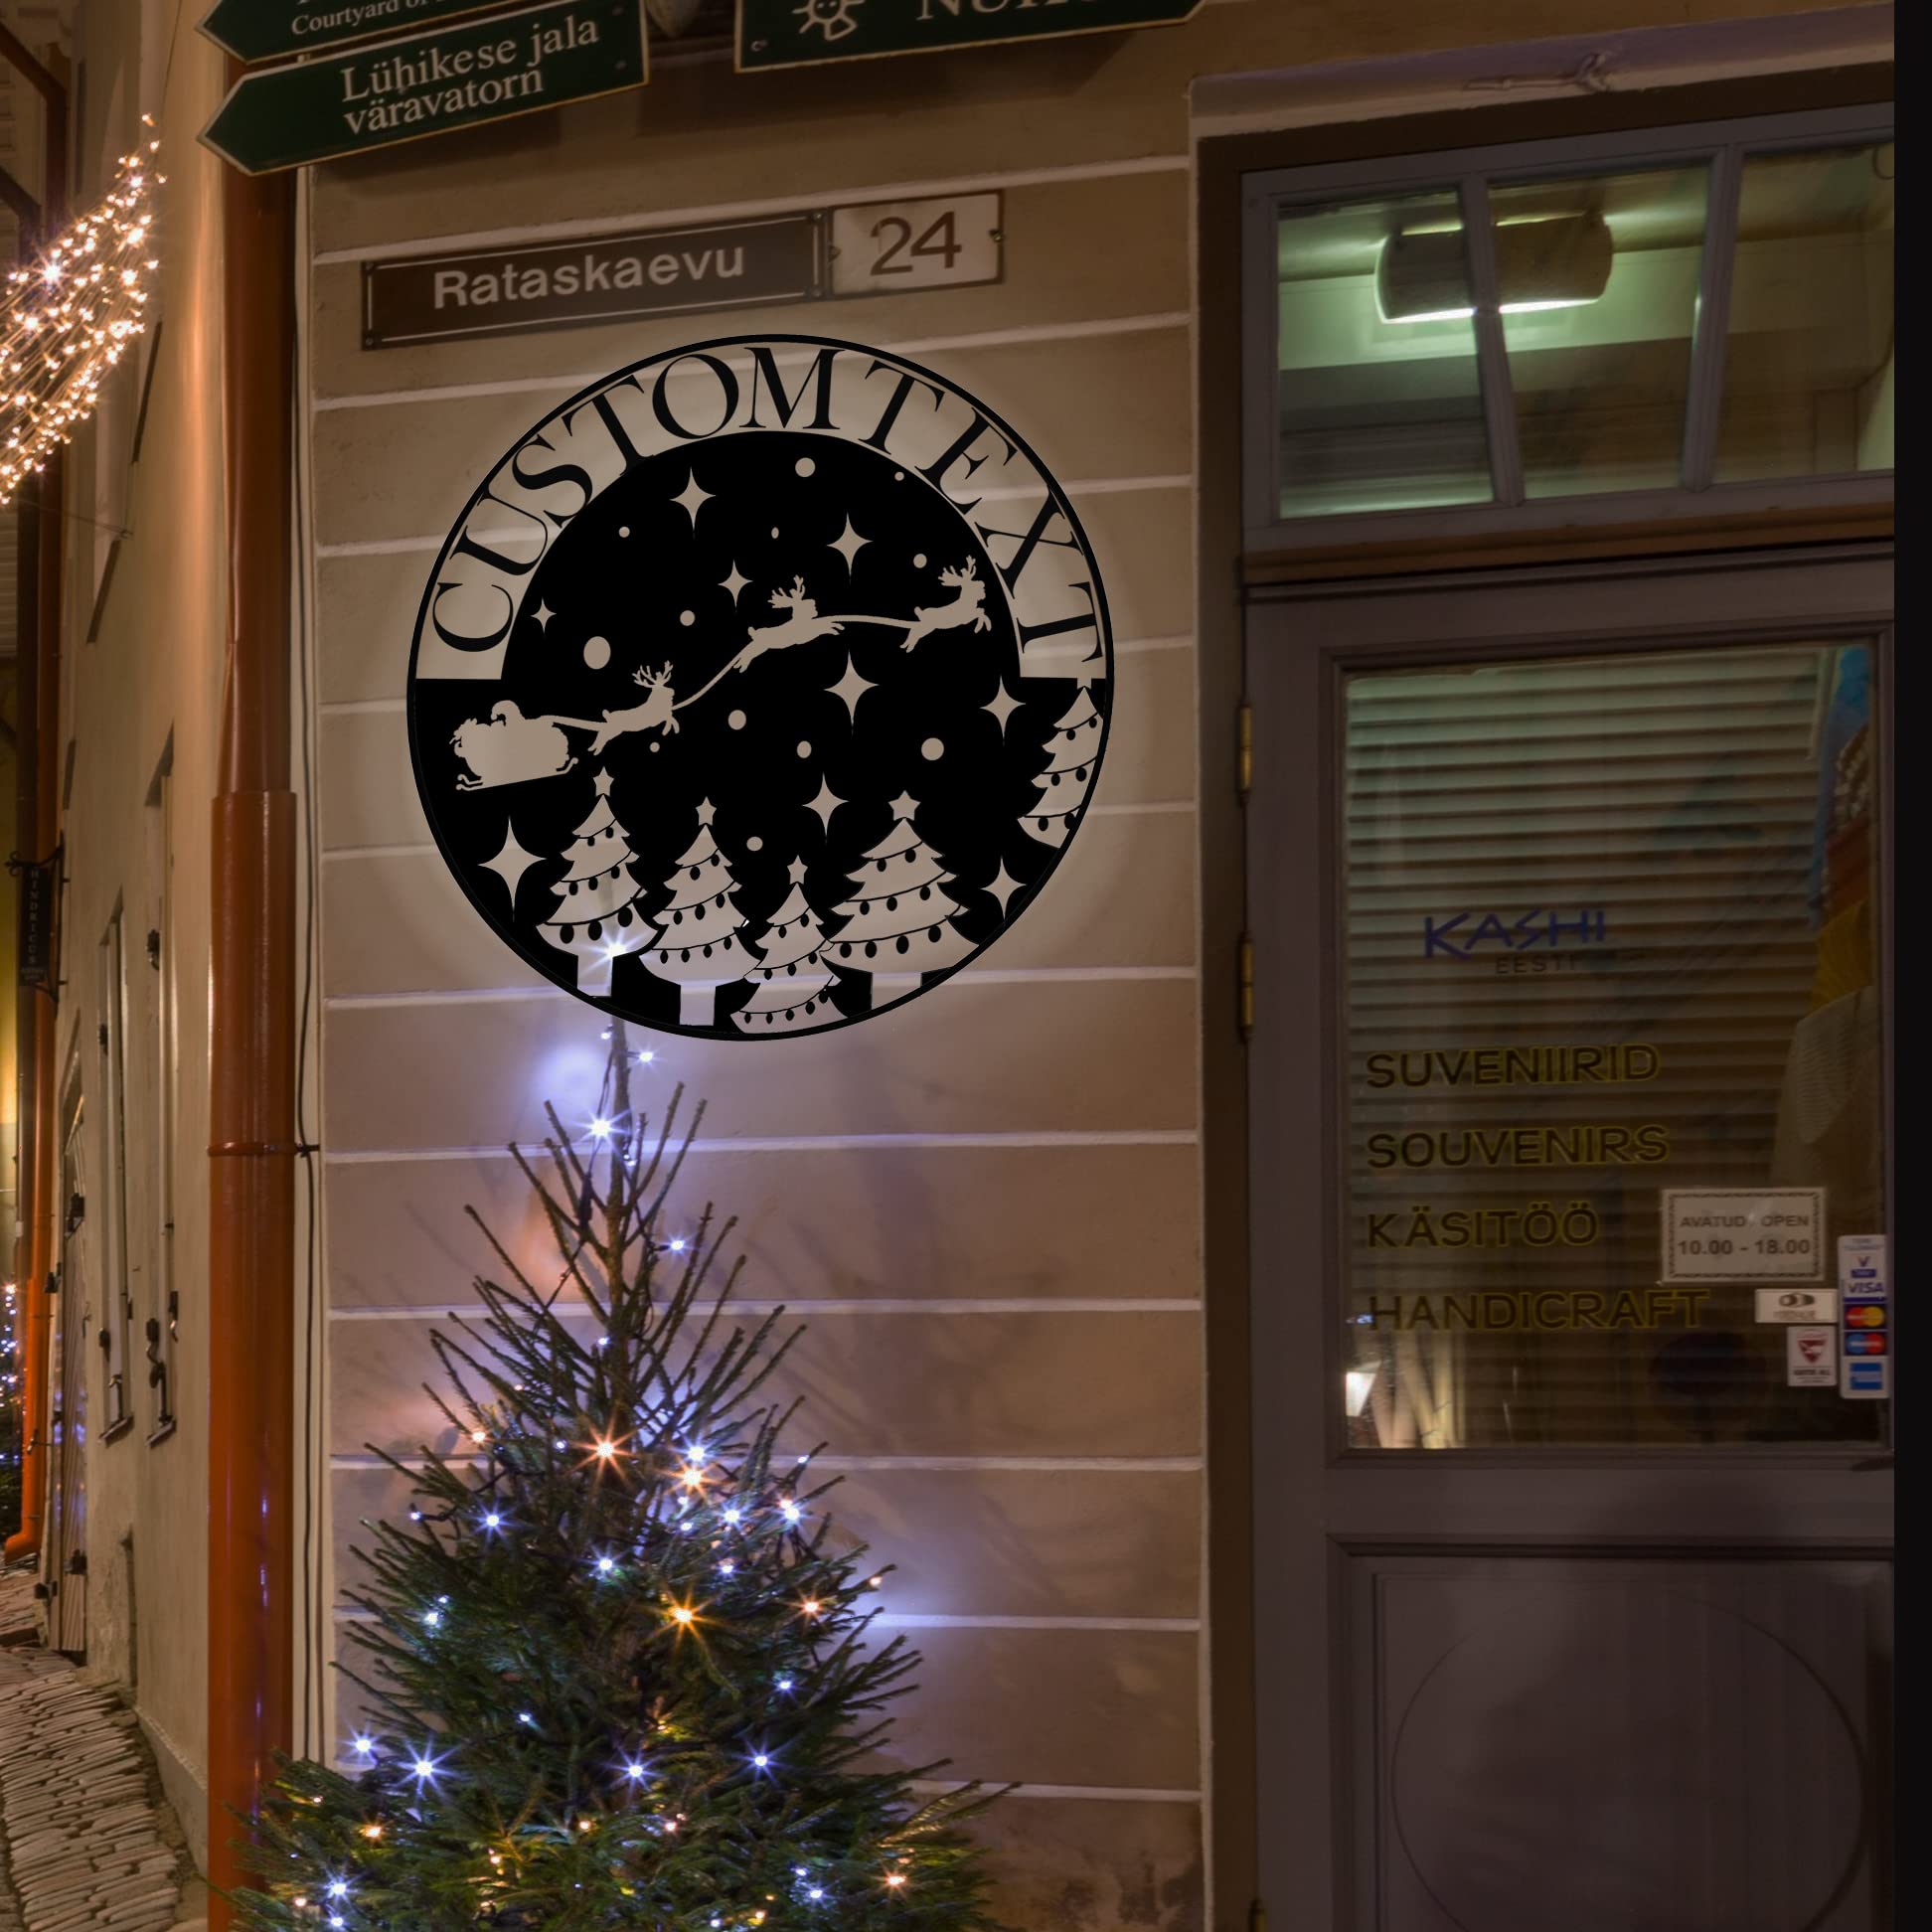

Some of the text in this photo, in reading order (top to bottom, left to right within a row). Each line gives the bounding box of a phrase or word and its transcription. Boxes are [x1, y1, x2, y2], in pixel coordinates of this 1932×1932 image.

[290, 0, 399, 36] Courtyard
[341, 15, 600, 101] Lühikese jala
[344, 70, 544, 134] väravatorn
[869, 211, 963, 277] 24
[433, 244, 745, 309] Rataskaevu
[432, 346, 1103, 663] CUSTOM TEXT
[1423, 907, 1606, 961] KASHI
[1495, 953, 1576, 974] EESTI
[1367, 1045, 1660, 1087] SUVENIIRID
[1368, 1125, 1670, 1168] SOUVENIRS
[1368, 1203, 1598, 1248] KÄSITÖÖ
[1679, 1214, 1810, 1227] AVATUD OPEN
[1678, 1239, 1733, 1255] 10.00
[1754, 1239, 1811, 1255] 18.00
[1368, 1290, 1709, 1330] HANDICRAFT
